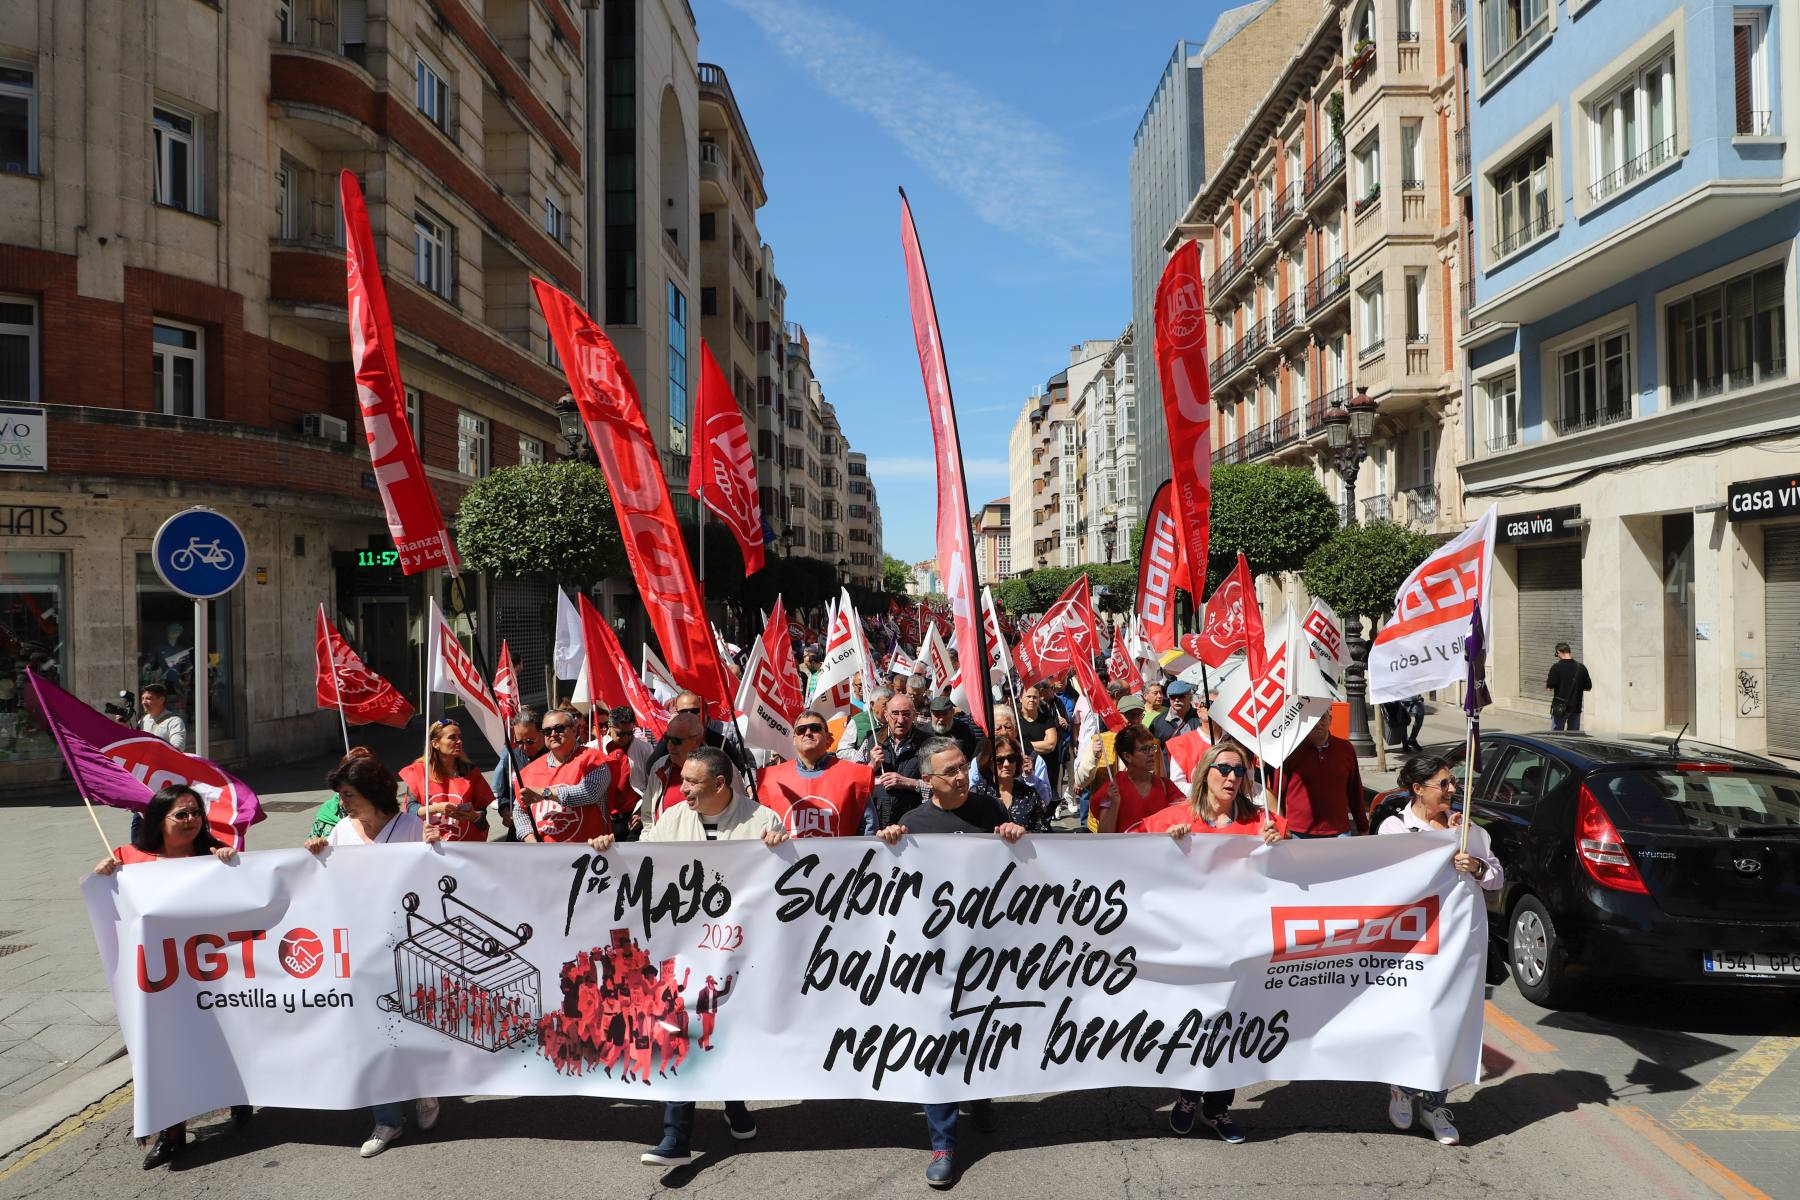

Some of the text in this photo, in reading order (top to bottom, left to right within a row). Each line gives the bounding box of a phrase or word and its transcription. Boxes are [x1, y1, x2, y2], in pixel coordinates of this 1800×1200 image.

[1732, 479, 1800, 513] casa vi
[1507, 514, 1553, 537] casa viva
[358, 551, 399, 566] 11:57
[589, 420, 696, 671] UGT
[832, 646, 856, 666] León
[1310, 640, 1332, 662] Burgos
[756, 704, 790, 737] Burgos
[790, 808, 833, 832] UGT
[775, 848, 1128, 940] Subir salarios
[697, 923, 744, 952] 2023
[1283, 905, 1428, 954] CCOO
[137, 928, 267, 994] UGT
[800, 924, 1138, 1021] bajar precios
[1266, 953, 1424, 976] comisiones obreras
[1716, 952, 1756, 971] 1541
[1263, 969, 1409, 991] de Castilla y León
[196, 985, 354, 1014] Castilla y León
[822, 995, 1290, 1091] repartir beneficios
